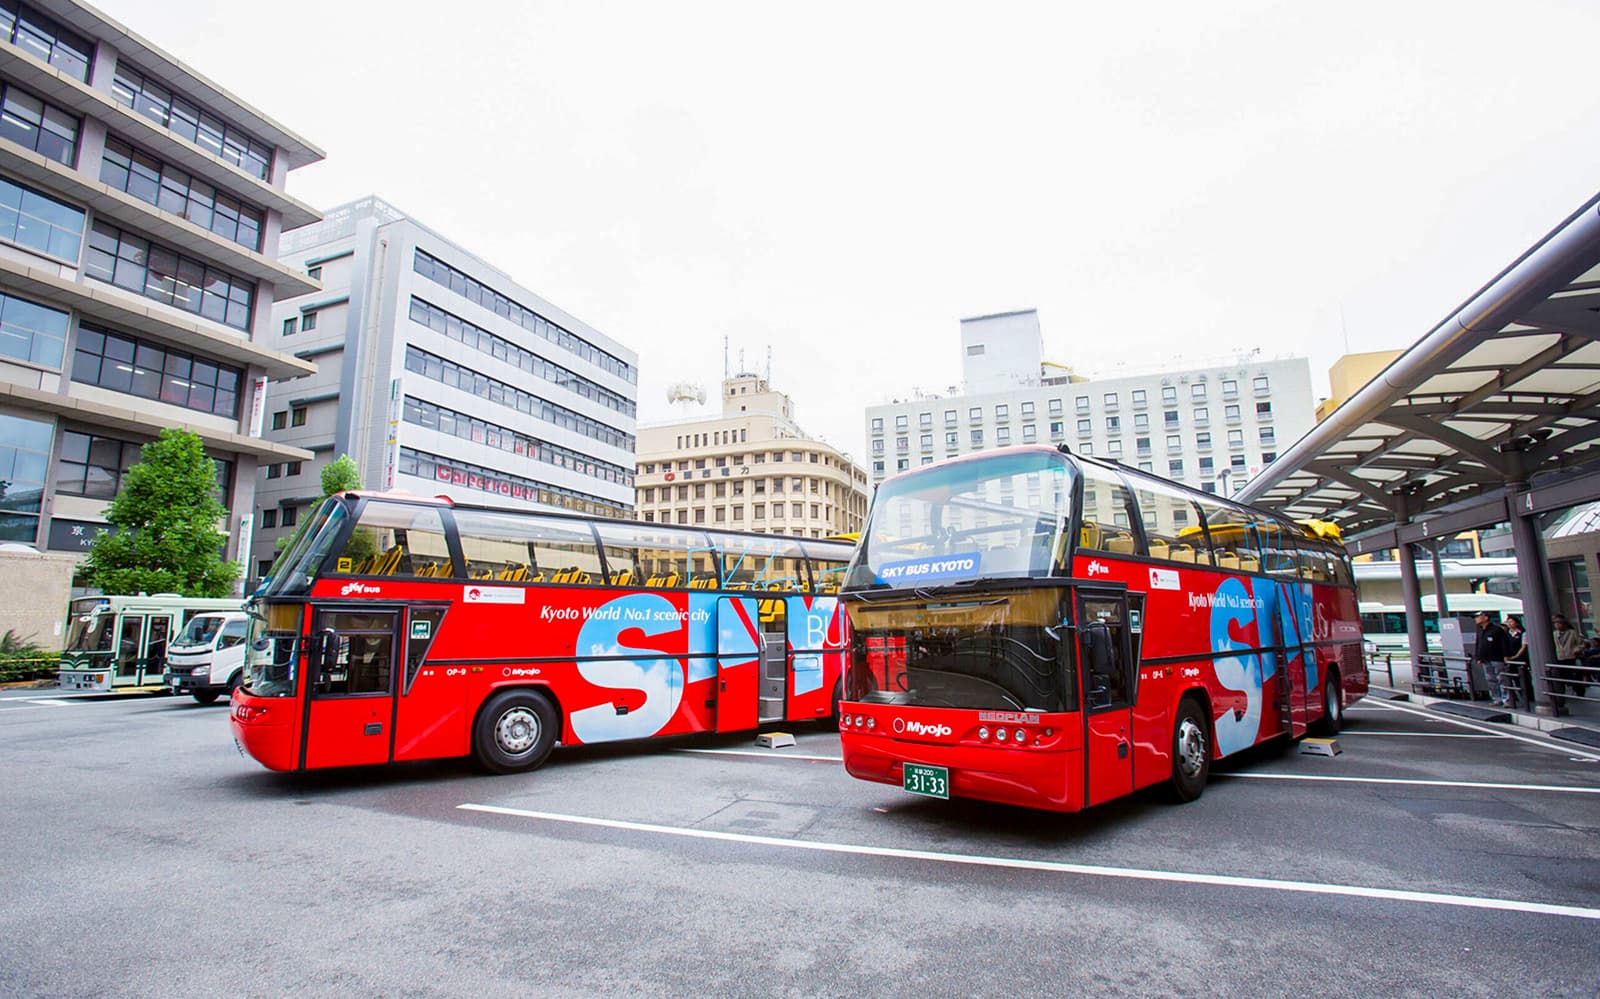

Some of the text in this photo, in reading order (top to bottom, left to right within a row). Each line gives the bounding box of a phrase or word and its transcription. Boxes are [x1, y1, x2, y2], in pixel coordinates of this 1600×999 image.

[1525, 493, 1533, 510] 4
[1422, 522, 1428, 536] 5
[881, 559, 974, 578] SKY BUS KYOTO
[1188, 592, 1207, 612] Kyoto
[540, 605, 711, 624] Kyoto World No.1 scenic city
[807, 615, 850, 650] BU
[512, 667, 541, 676] Myojo
[906, 721, 952, 737] Myojo
